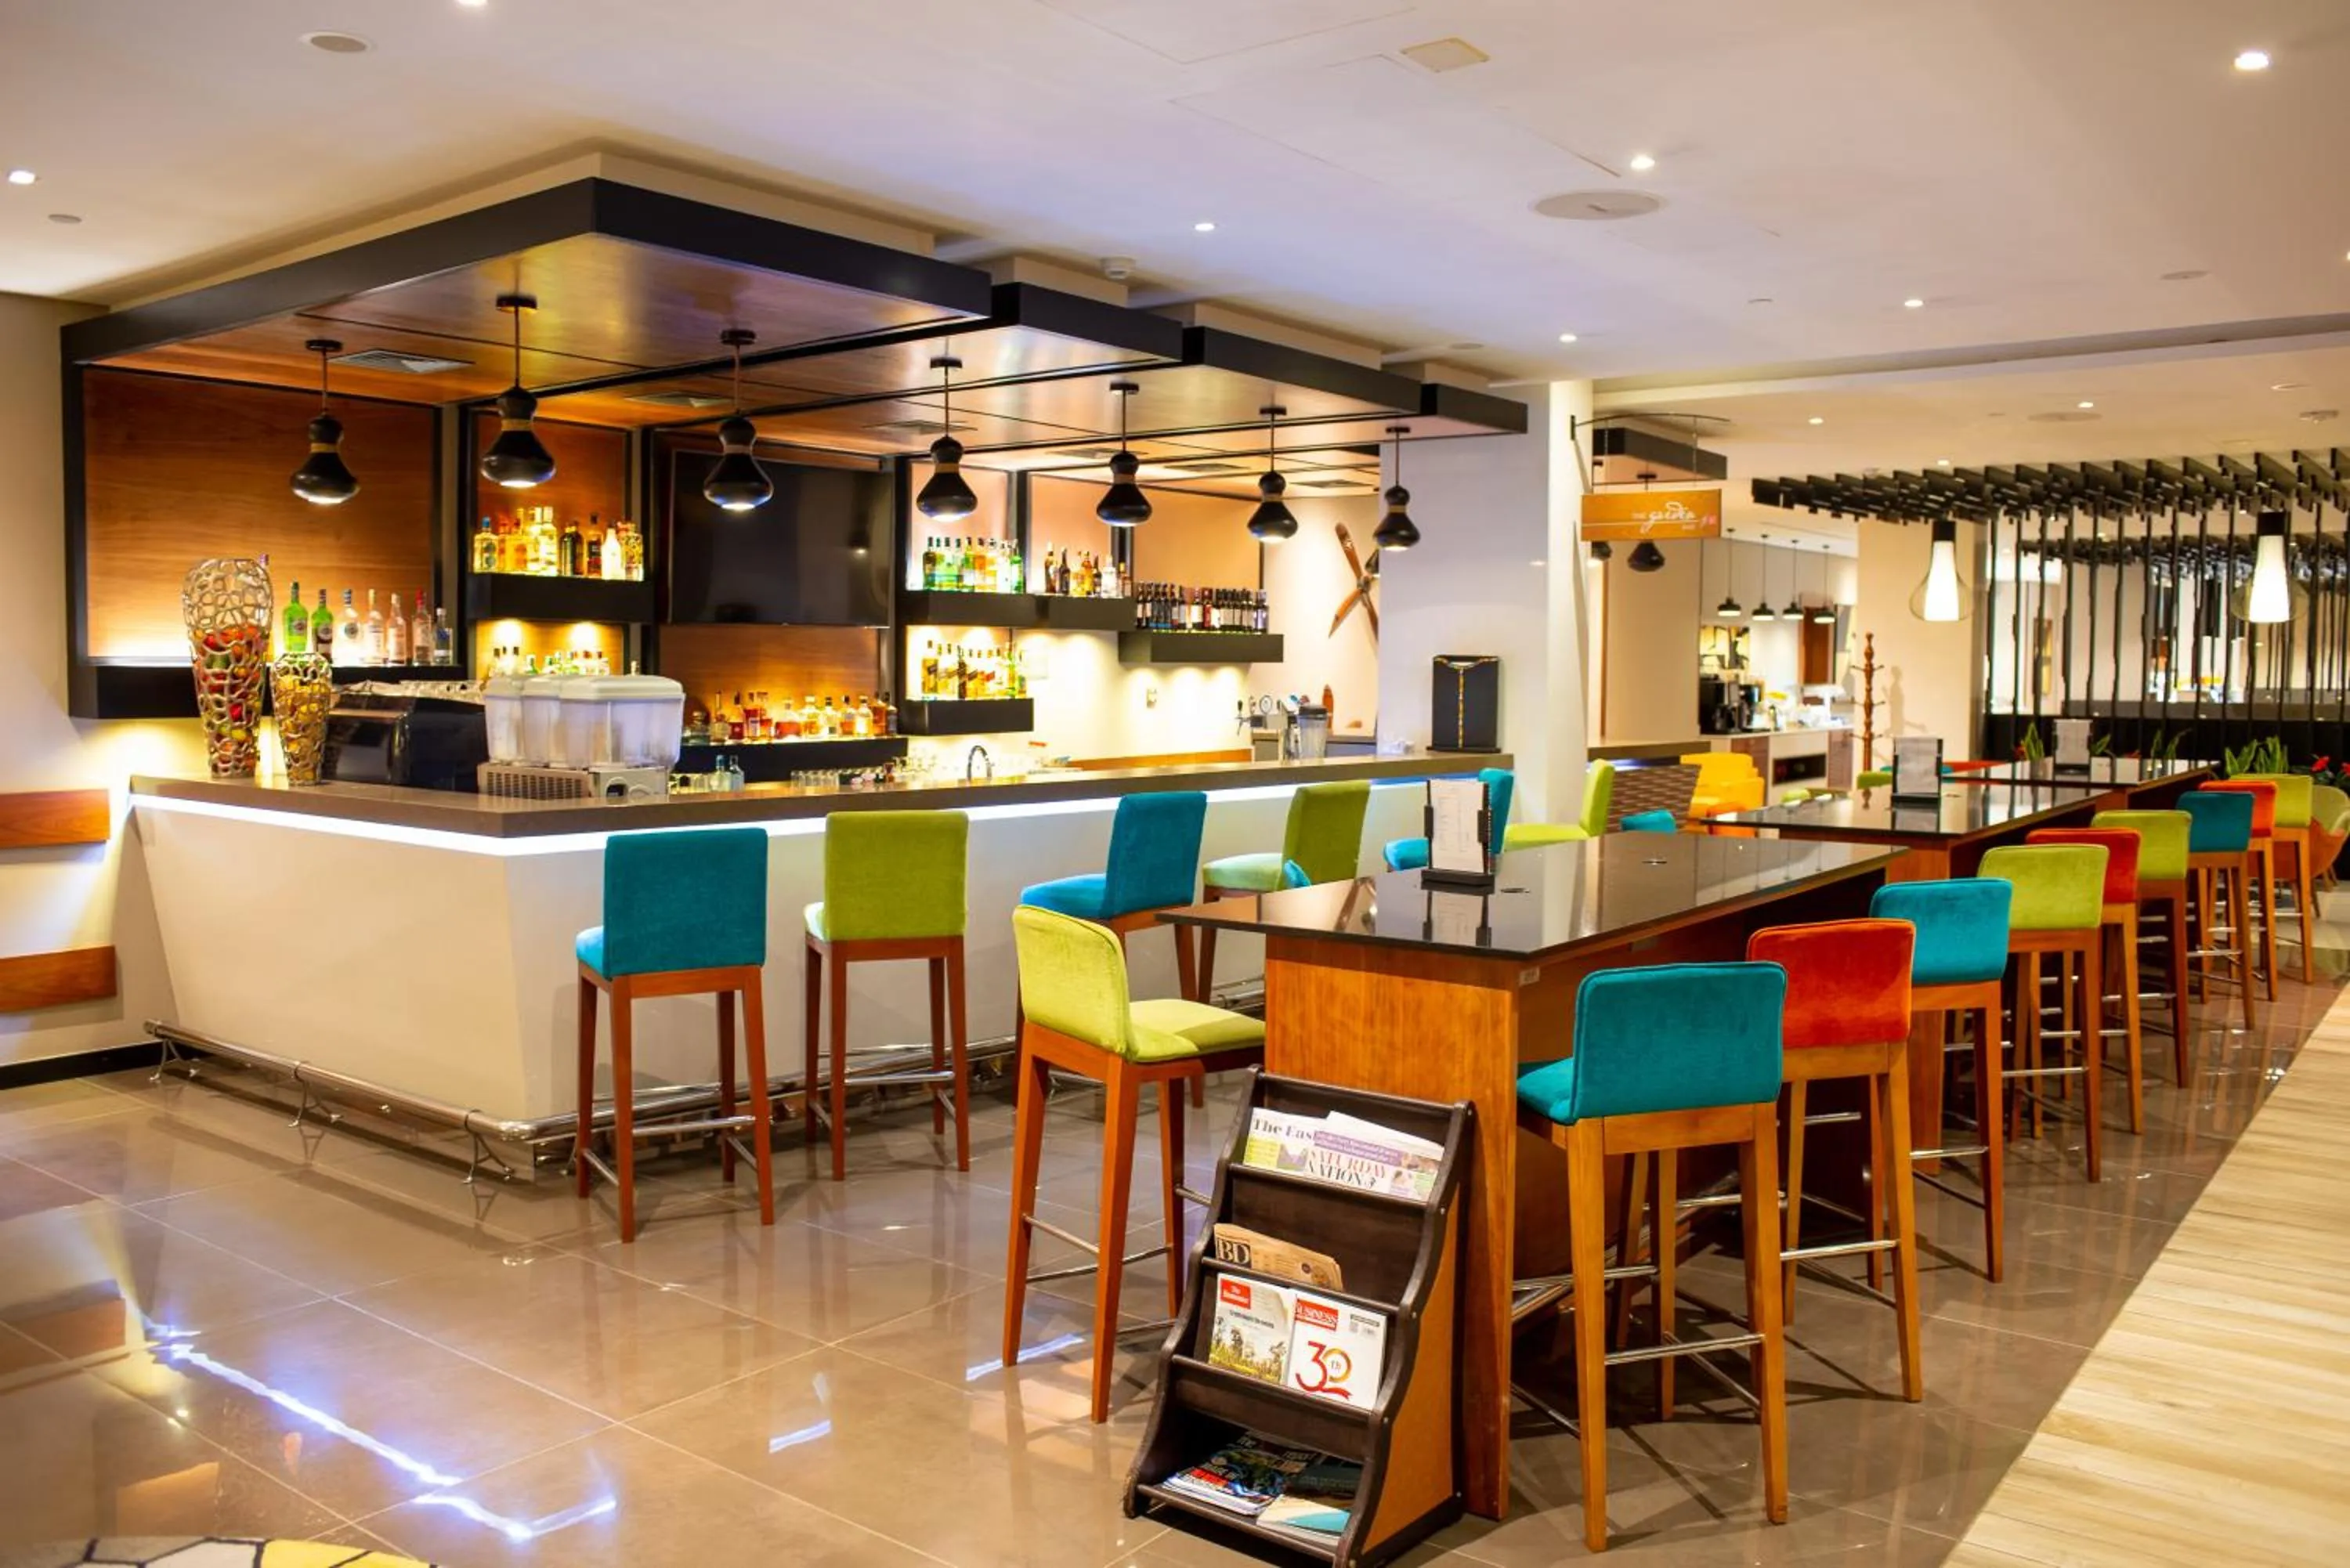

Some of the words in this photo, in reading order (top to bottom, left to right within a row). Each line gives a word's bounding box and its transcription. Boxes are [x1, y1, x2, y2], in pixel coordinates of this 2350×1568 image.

[1253, 1118, 1282, 1134] The
[1307, 1159, 1365, 1187] NATION
[1310, 1149, 1387, 1179] SATURDAY
[1217, 1237, 1250, 1264] BD
